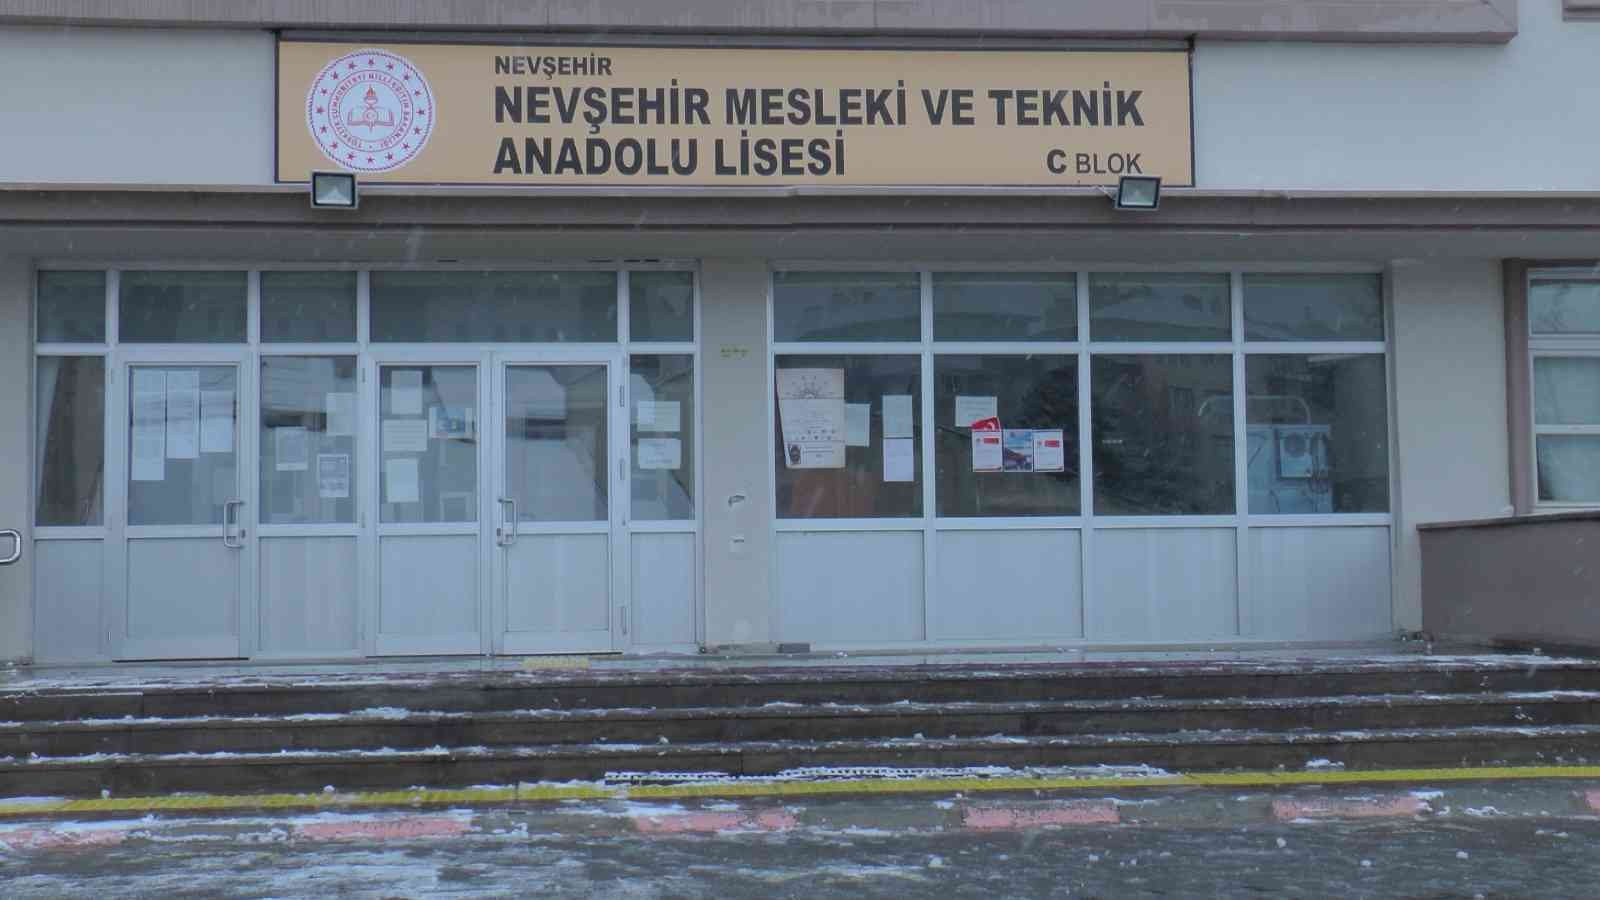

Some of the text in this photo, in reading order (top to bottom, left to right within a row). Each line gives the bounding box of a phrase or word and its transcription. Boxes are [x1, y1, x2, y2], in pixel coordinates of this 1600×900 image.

[495, 53, 612, 80] NEVŞEHİR
[495, 79, 1145, 135] NEVŞEHİR MESLEKİ VE TEKNİK
[493, 129, 845, 176] ANADOLU LİSESİ
[1046, 149, 1143, 175] C BLOK
